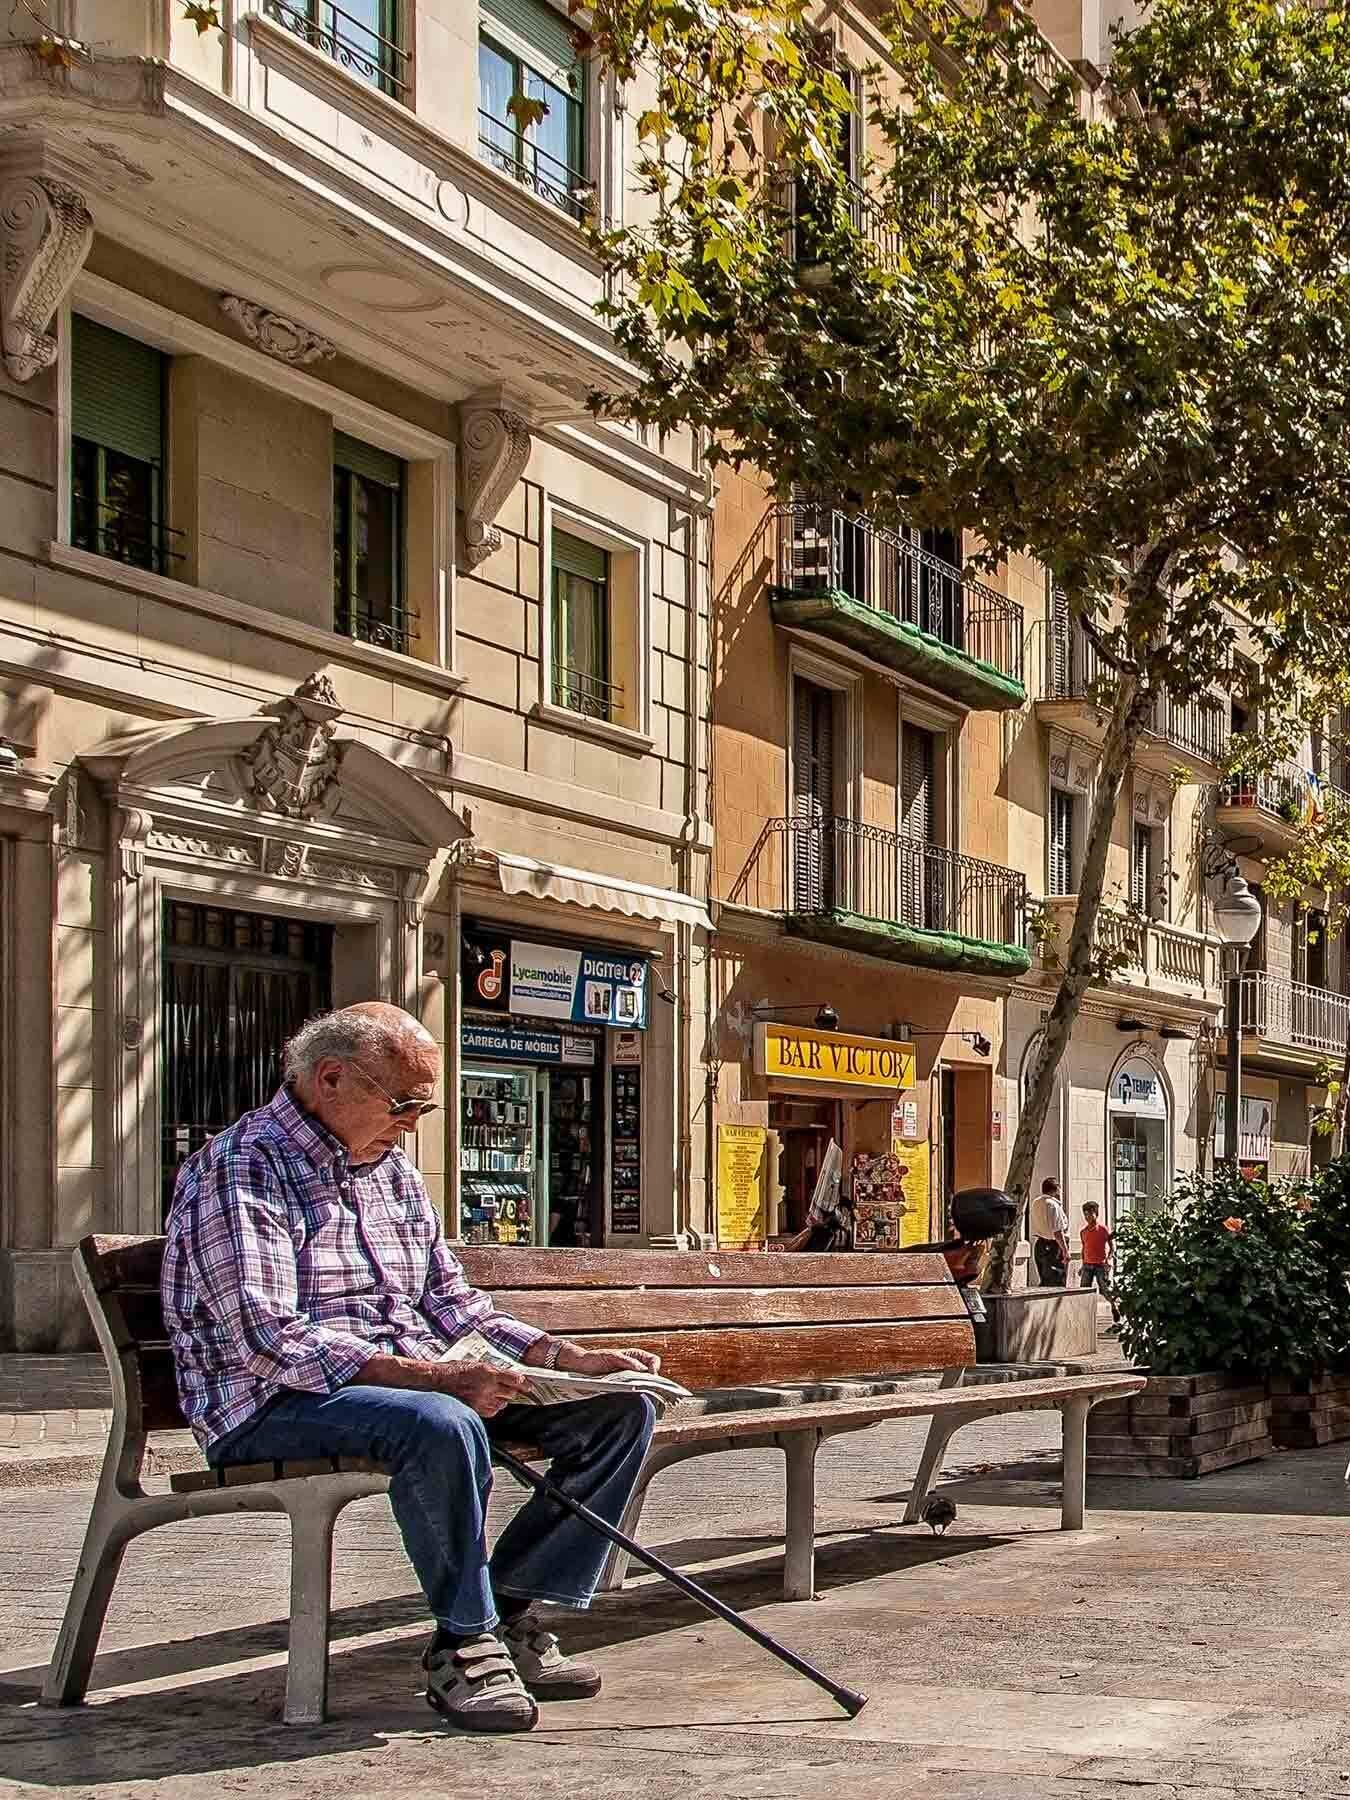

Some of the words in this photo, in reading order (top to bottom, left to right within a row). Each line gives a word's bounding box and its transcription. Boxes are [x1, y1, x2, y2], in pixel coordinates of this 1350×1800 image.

[512, 964, 572, 985] Lycamobile
[584, 959, 629, 981] DIGIT@L
[510, 1039, 523, 1051] DE
[779, 1035, 822, 1070] BAR
[828, 1042, 904, 1080] VICTOR
[1131, 1078, 1157, 1096] TEMPLE
